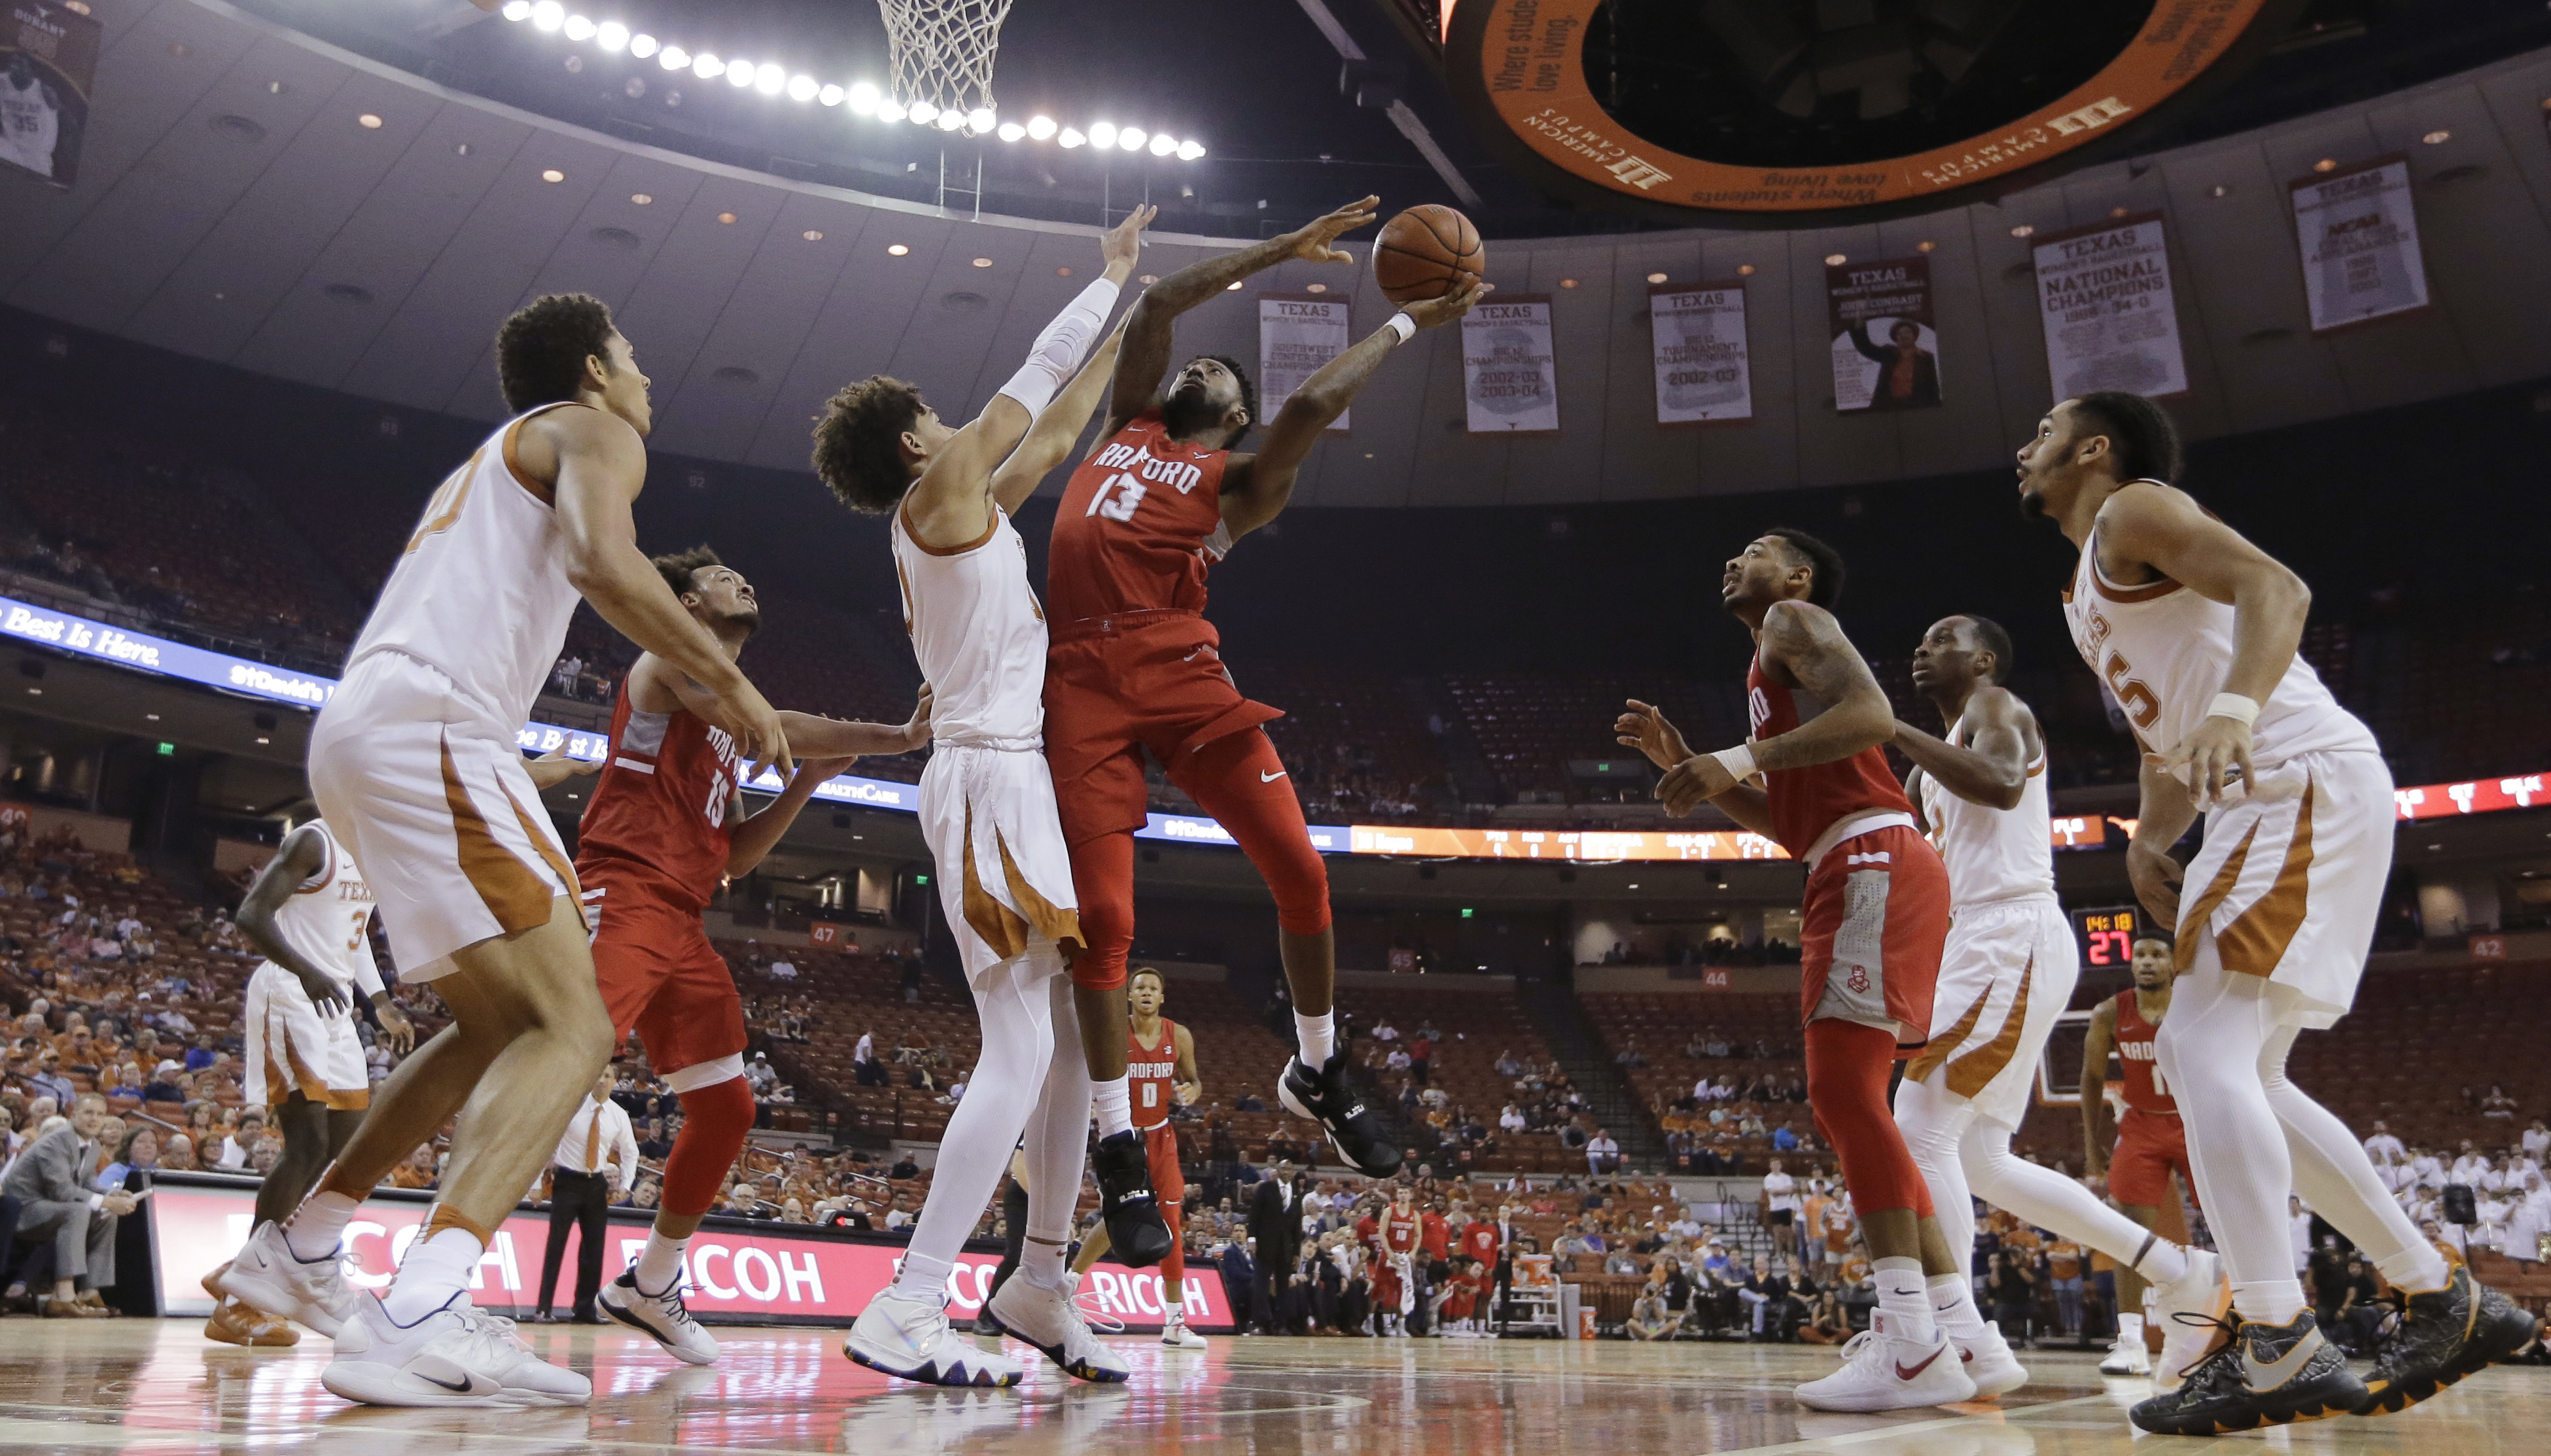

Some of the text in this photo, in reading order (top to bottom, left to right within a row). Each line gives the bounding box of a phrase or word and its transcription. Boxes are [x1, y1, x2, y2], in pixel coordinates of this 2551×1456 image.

[1492, 0, 1539, 91] Where stude
[1522, 116, 1610, 162] AMERICAN
[1539, 109, 1625, 156] CAMPUS
[2060, 230, 2137, 259] TEXAS
[1848, 267, 1907, 285] TEXAS
[2045, 258, 2162, 296] NATIONAL
[1670, 292, 1725, 309] TEXAS
[2046, 275, 2164, 312] CHAMPIONS
[1278, 303, 1330, 317] TEXAS
[1479, 305, 1532, 319] TEXAS
[1479, 371, 1540, 384] 2002-03
[1668, 369, 1734, 386] 2002-03
[1480, 385, 1540, 398] 2003-04
[1085, 472, 1148, 523] 13
[4, 607, 160, 667] Best Is Here.
[2104, 650, 2161, 731] 5
[540, 729, 588, 756] Bst
[590, 738, 608, 759] Is
[704, 769, 730, 829] 15
[338, 880, 376, 902] TEX
[347, 910, 368, 952] 3
[814, 927, 834, 943] 47
[2089, 931, 2133, 965] 27
[2475, 941, 2500, 956] 42
[1392, 954, 1411, 967] 45
[1706, 972, 1727, 986] 44
[1127, 1062, 1174, 1079] ADFORD
[1142, 1083, 1157, 1107] 0
